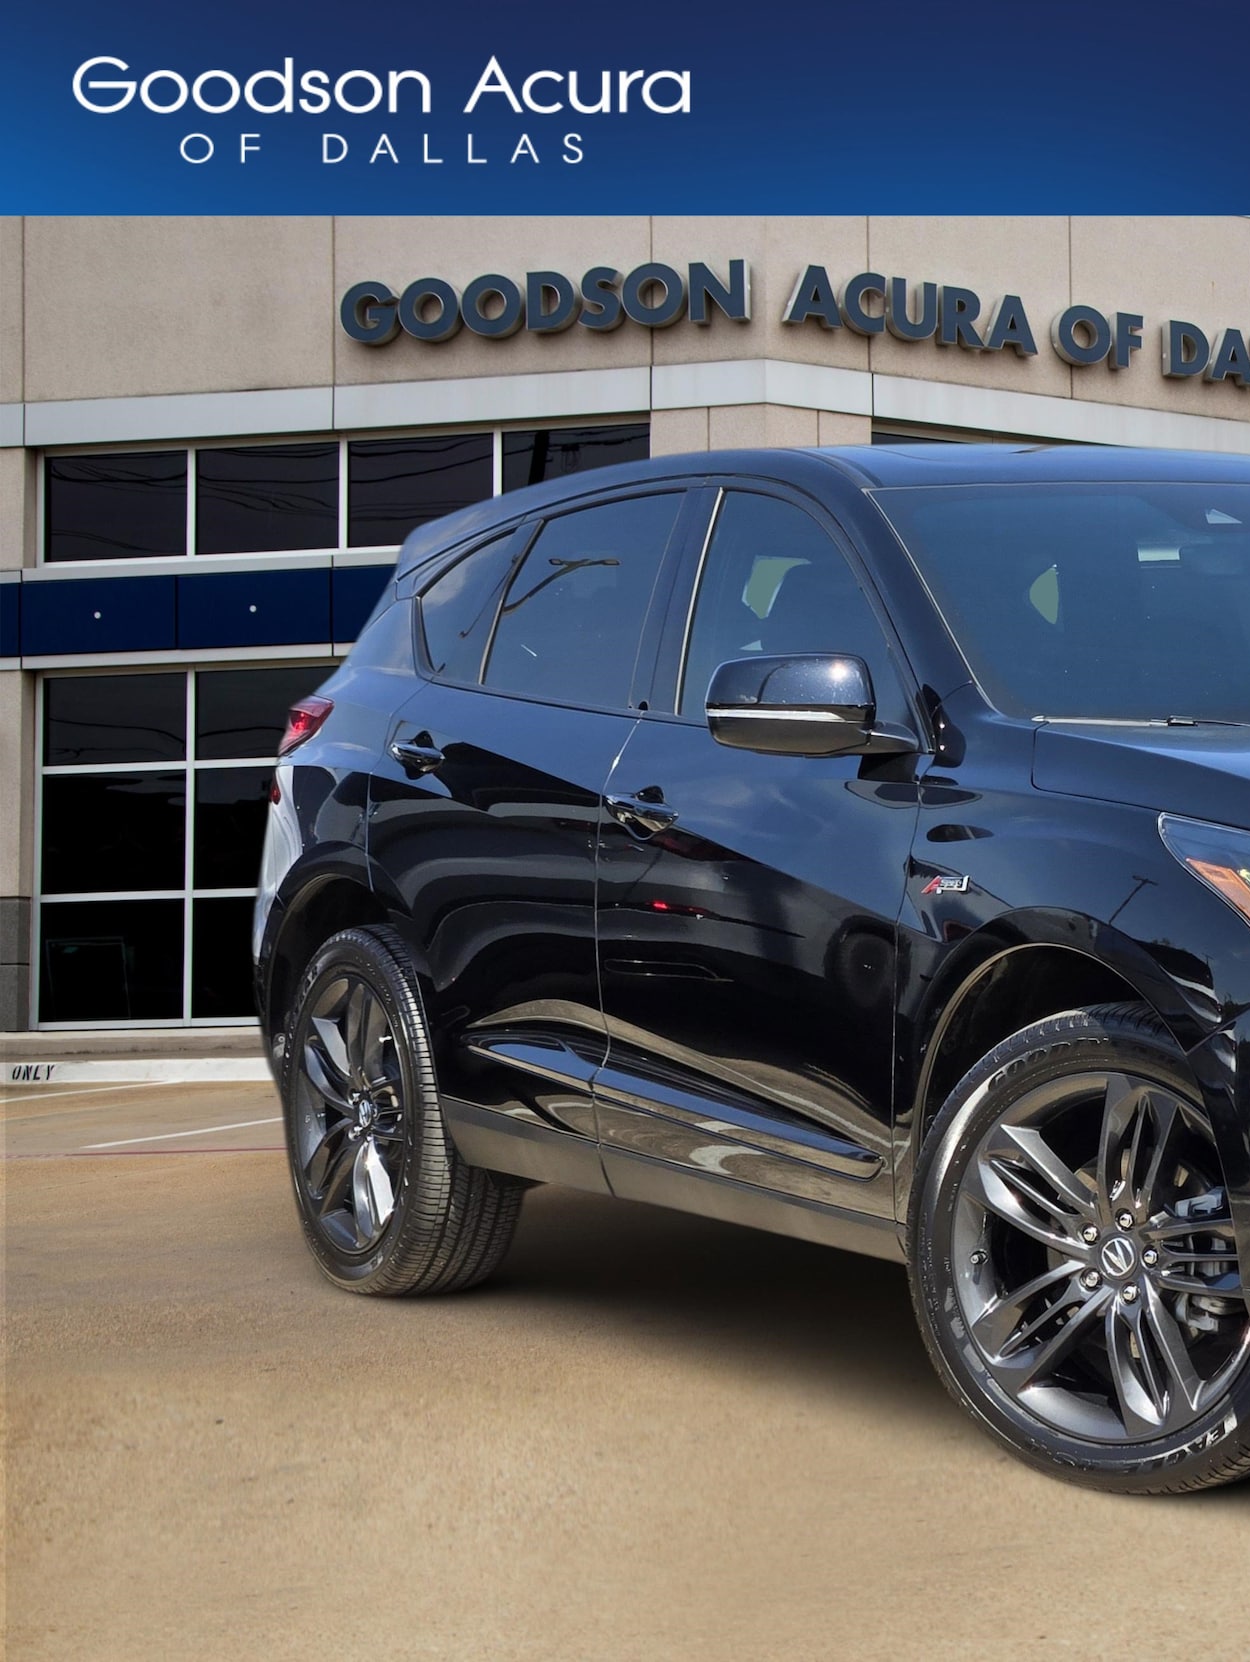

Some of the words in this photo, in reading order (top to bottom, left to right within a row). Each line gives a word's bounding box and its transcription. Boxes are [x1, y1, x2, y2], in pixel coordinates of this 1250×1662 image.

[340, 258, 752, 345] GOODSON
[782, 263, 1038, 360] ACURA
[1051, 304, 1144, 370] OF
[12, 1064, 55, 1081] ONLY
